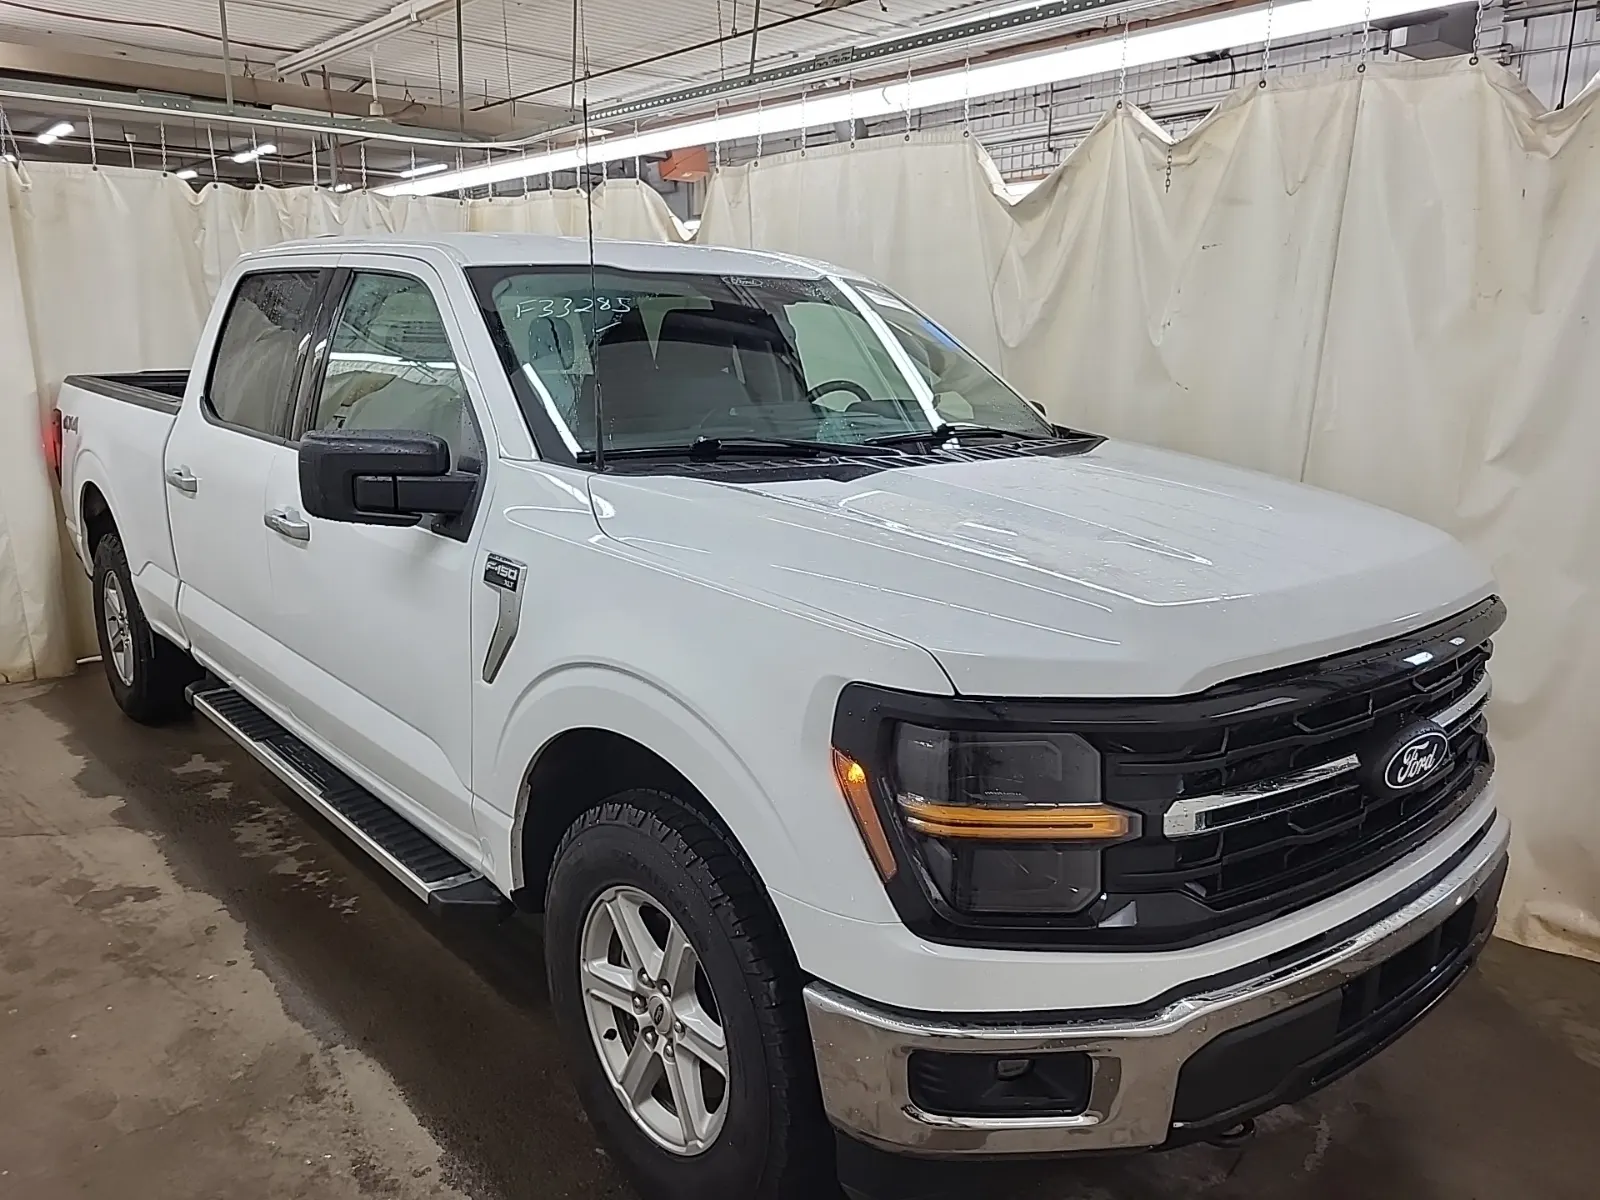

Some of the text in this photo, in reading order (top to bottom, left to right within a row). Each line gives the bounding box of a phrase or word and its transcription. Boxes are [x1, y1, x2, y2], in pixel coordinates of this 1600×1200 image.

[515, 297, 631, 319] F33285
[486, 561, 518, 581] F-150
[1397, 740, 1439, 784] Ford
